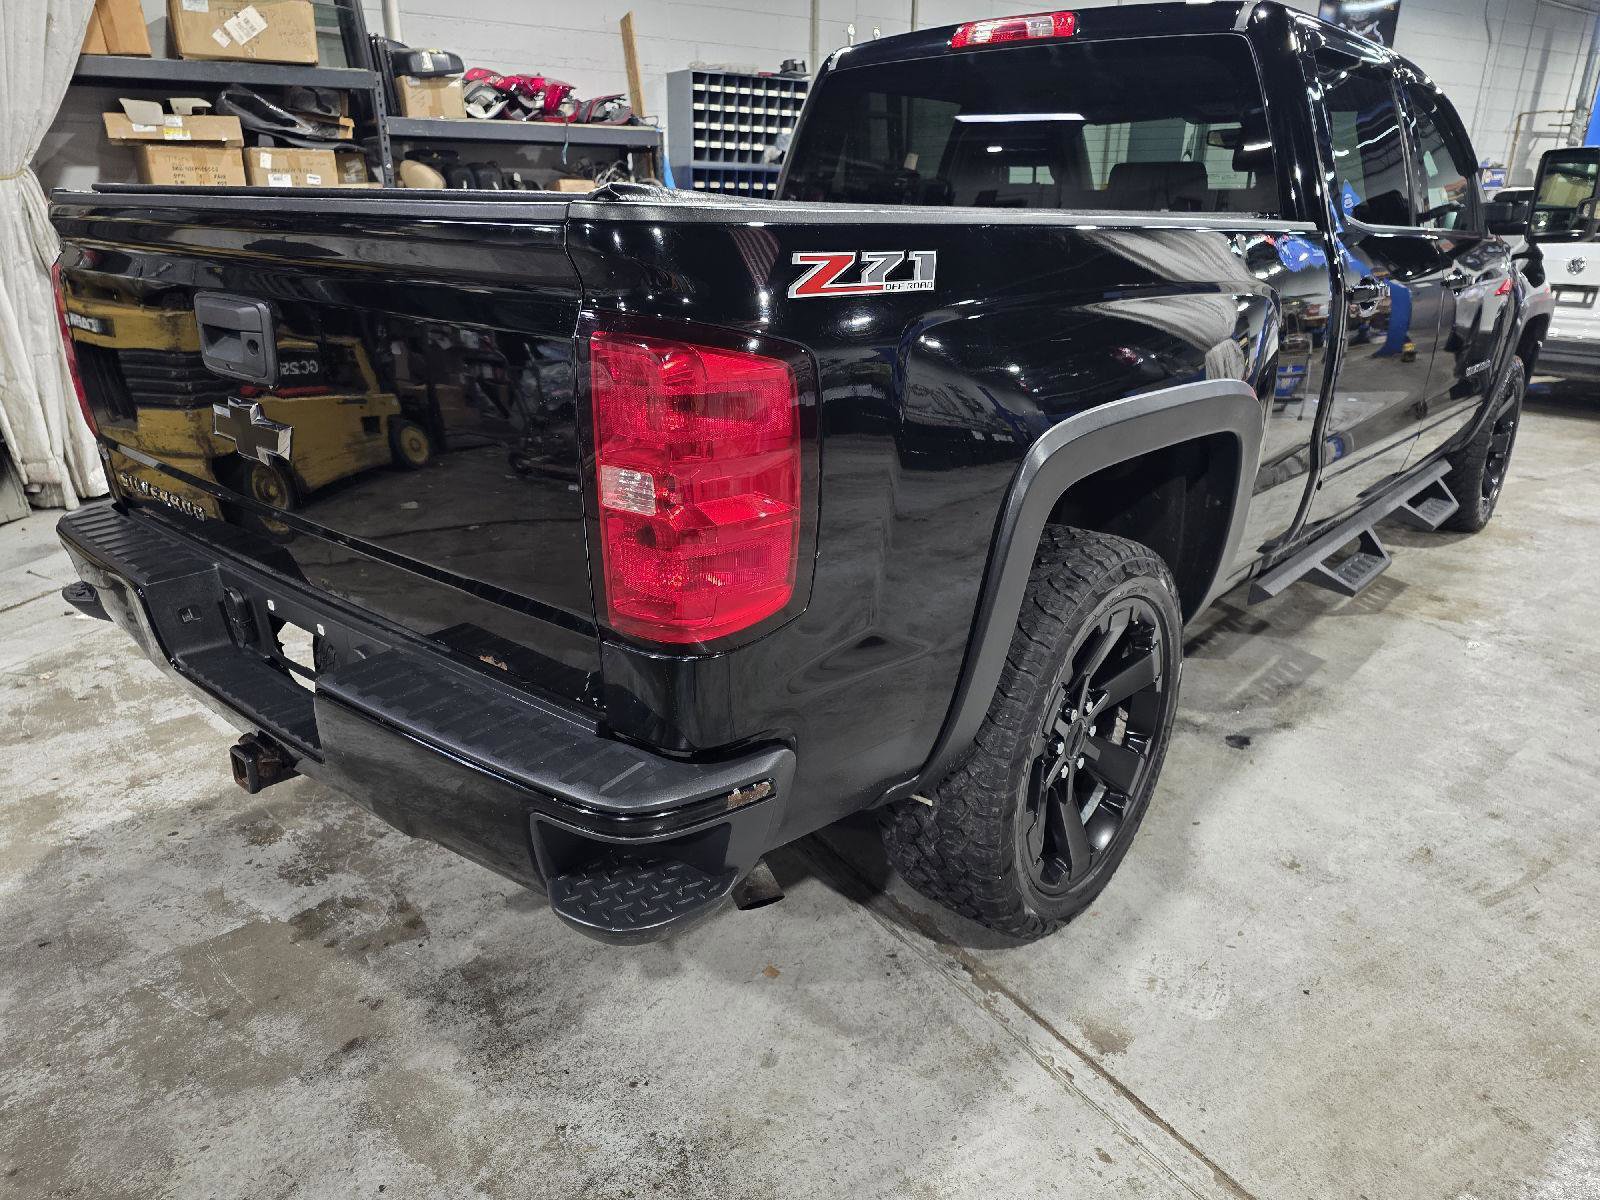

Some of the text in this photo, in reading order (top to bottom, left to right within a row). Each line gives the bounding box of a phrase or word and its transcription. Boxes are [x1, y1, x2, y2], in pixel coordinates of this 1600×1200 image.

[788, 250, 937, 298] Z71
[885, 281, 933, 291] OFF ROAD
